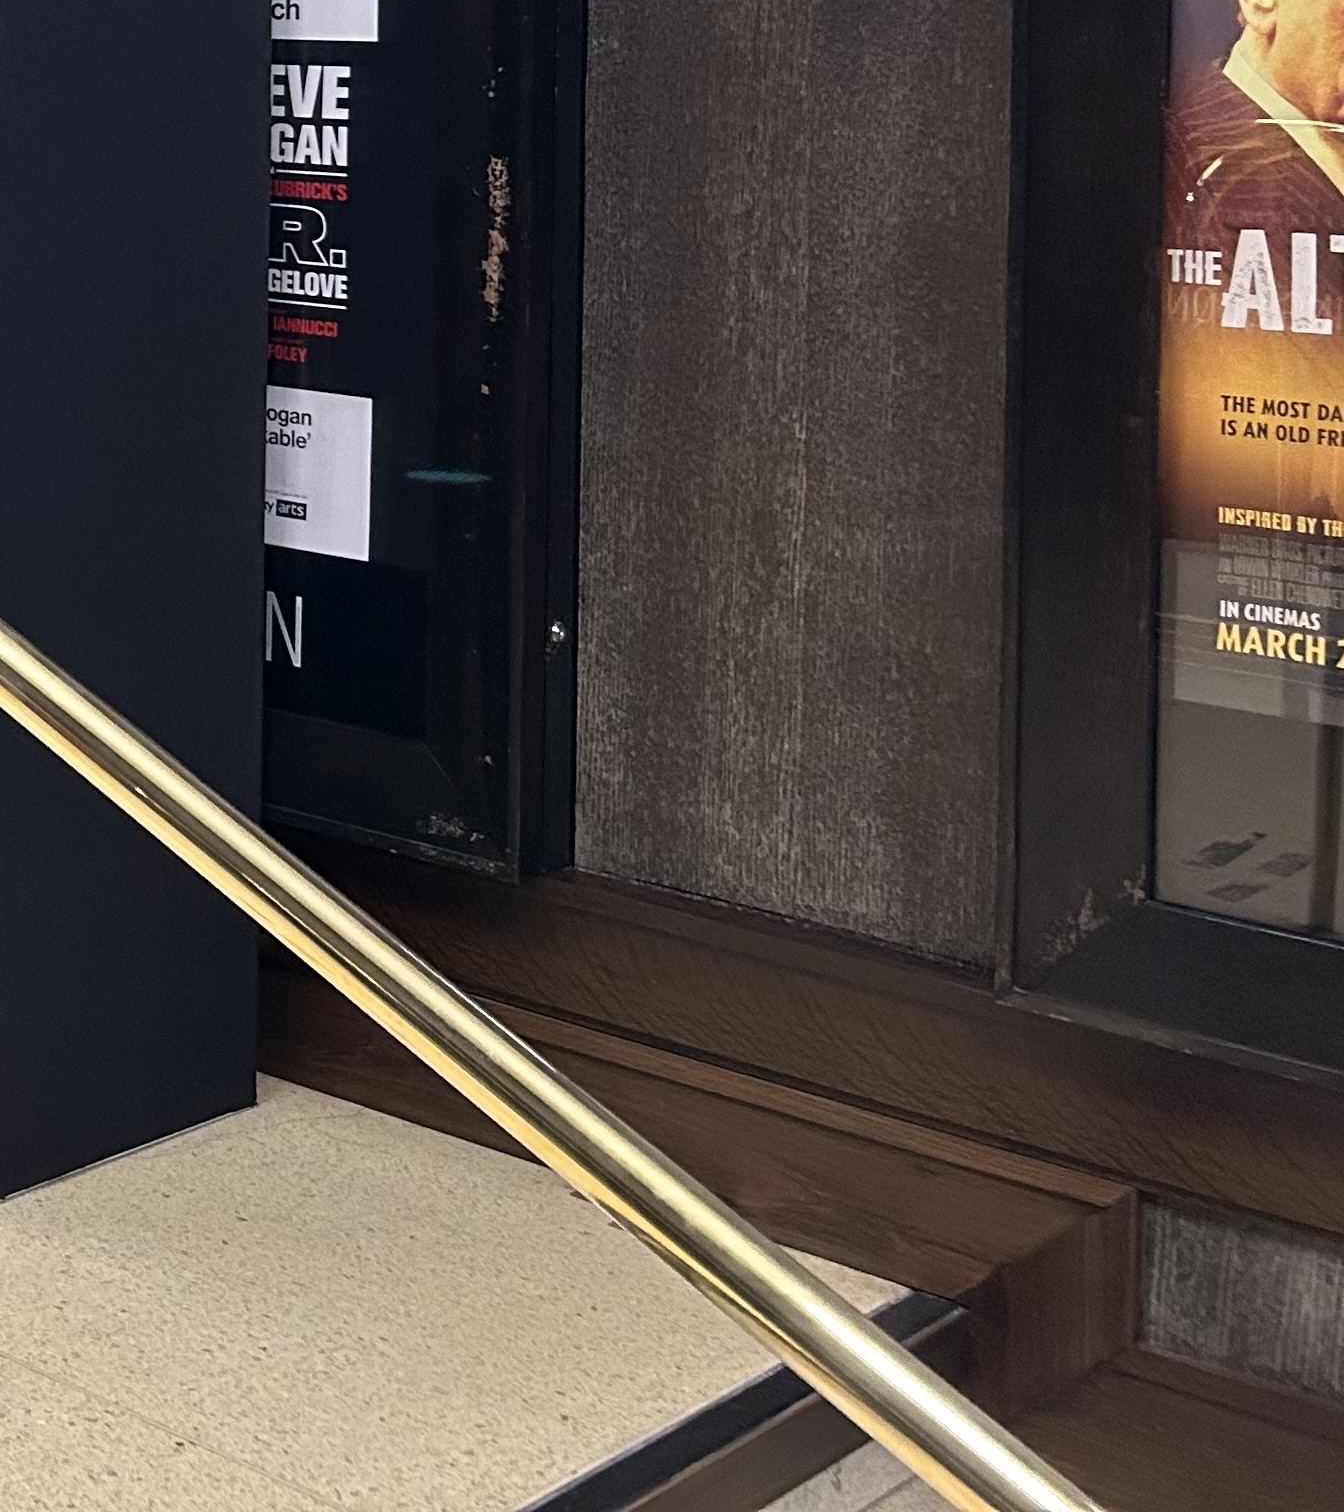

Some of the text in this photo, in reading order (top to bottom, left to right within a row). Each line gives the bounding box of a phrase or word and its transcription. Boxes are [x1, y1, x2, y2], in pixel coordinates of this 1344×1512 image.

[270, 123, 348, 167] GAN
[1168, 249, 1222, 285] THE
[268, 268, 348, 300] GELOVE
[1221, 395, 1255, 413] THE
[1262, 400, 1310, 418] MOST
[1221, 420, 1236, 435] IS
[1244, 423, 1268, 439] AN
[1276, 426, 1309, 443] OLD
[277, 503, 305, 517] arts
[1219, 507, 1291, 531] INSPIRED
[1298, 516, 1316, 534] BY
[1220, 600, 1320, 630] IN CINEMAS
[1217, 623, 1325, 665] MARCH
